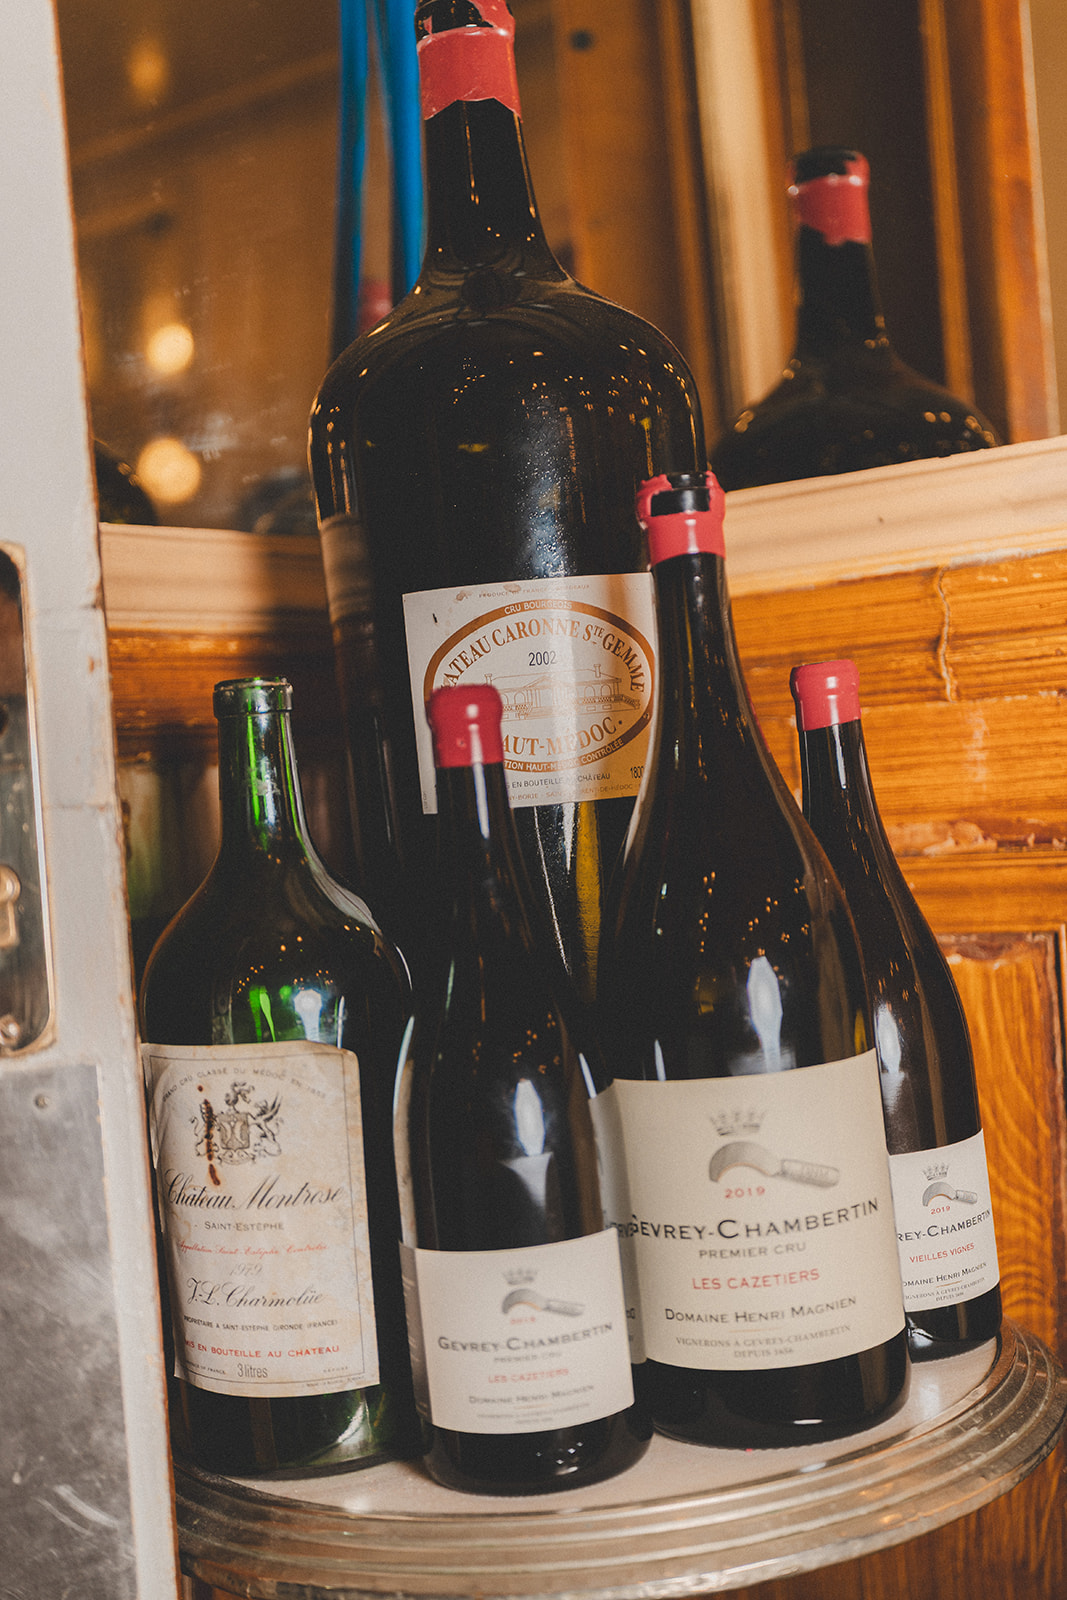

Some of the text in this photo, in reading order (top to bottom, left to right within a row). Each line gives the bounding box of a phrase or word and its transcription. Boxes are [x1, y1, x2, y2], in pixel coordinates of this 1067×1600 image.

[504, 600, 573, 616] CRU BOURGEOIS
[442, 635, 492, 688] ATEAU
[492, 617, 581, 647] CARONNE
[602, 633, 645, 693] GEMME
[528, 651, 557, 667] 2002
[502, 716, 617, 757] AUT-MÉDOC
[511, 780, 523, 789] EN
[179, 1075, 193, 1086] CRU
[233, 1067, 246, 1075] DU
[236, 1174, 342, 1210] Montrose
[724, 1186, 766, 1199] 2019
[930, 1205, 951, 1215] 2019
[896, 1209, 991, 1242] REY-CHAMBERTIN
[698, 1241, 807, 1260] PREMIER CRU
[909, 1242, 975, 1263] VIEILLES VIGNES
[692, 1268, 820, 1290] LES CAZETIERS
[936, 1271, 961, 1282] HENRI
[665, 1296, 857, 1324] DOMAINE HENRI MAGNIEN
[273, 1323, 303, 1332] GIRONDE
[197, 1343, 207, 1352] EN
[211, 1346, 261, 1358] BOUTEILLE
[267, 1350, 282, 1358] AU
[675, 1336, 732, 1348] VIGNERONS
